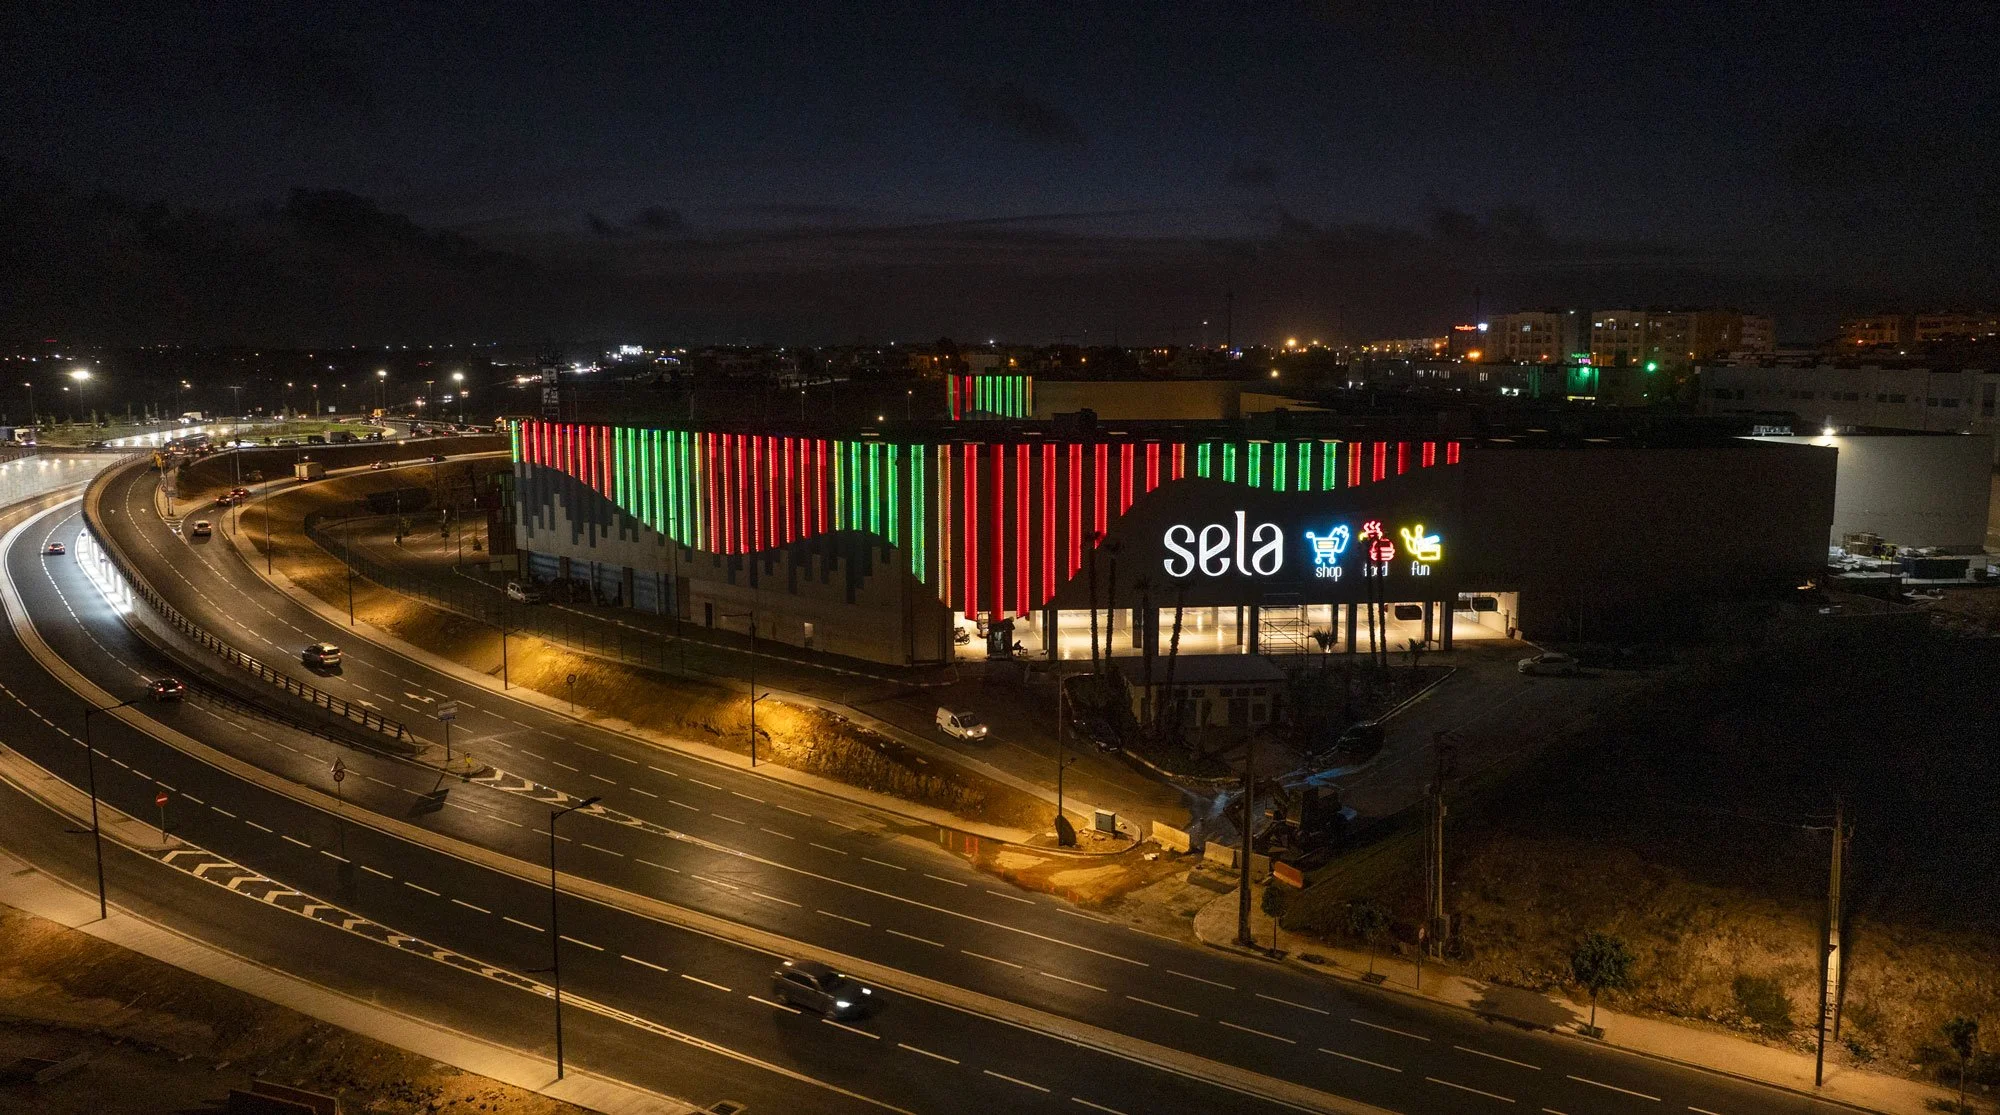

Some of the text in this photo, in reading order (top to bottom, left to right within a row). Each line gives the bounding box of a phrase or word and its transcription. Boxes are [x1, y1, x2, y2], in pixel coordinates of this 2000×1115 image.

[1164, 510, 1284, 577] sela
[1315, 561, 1342, 582] shop
[1411, 560, 1430, 576] fun
